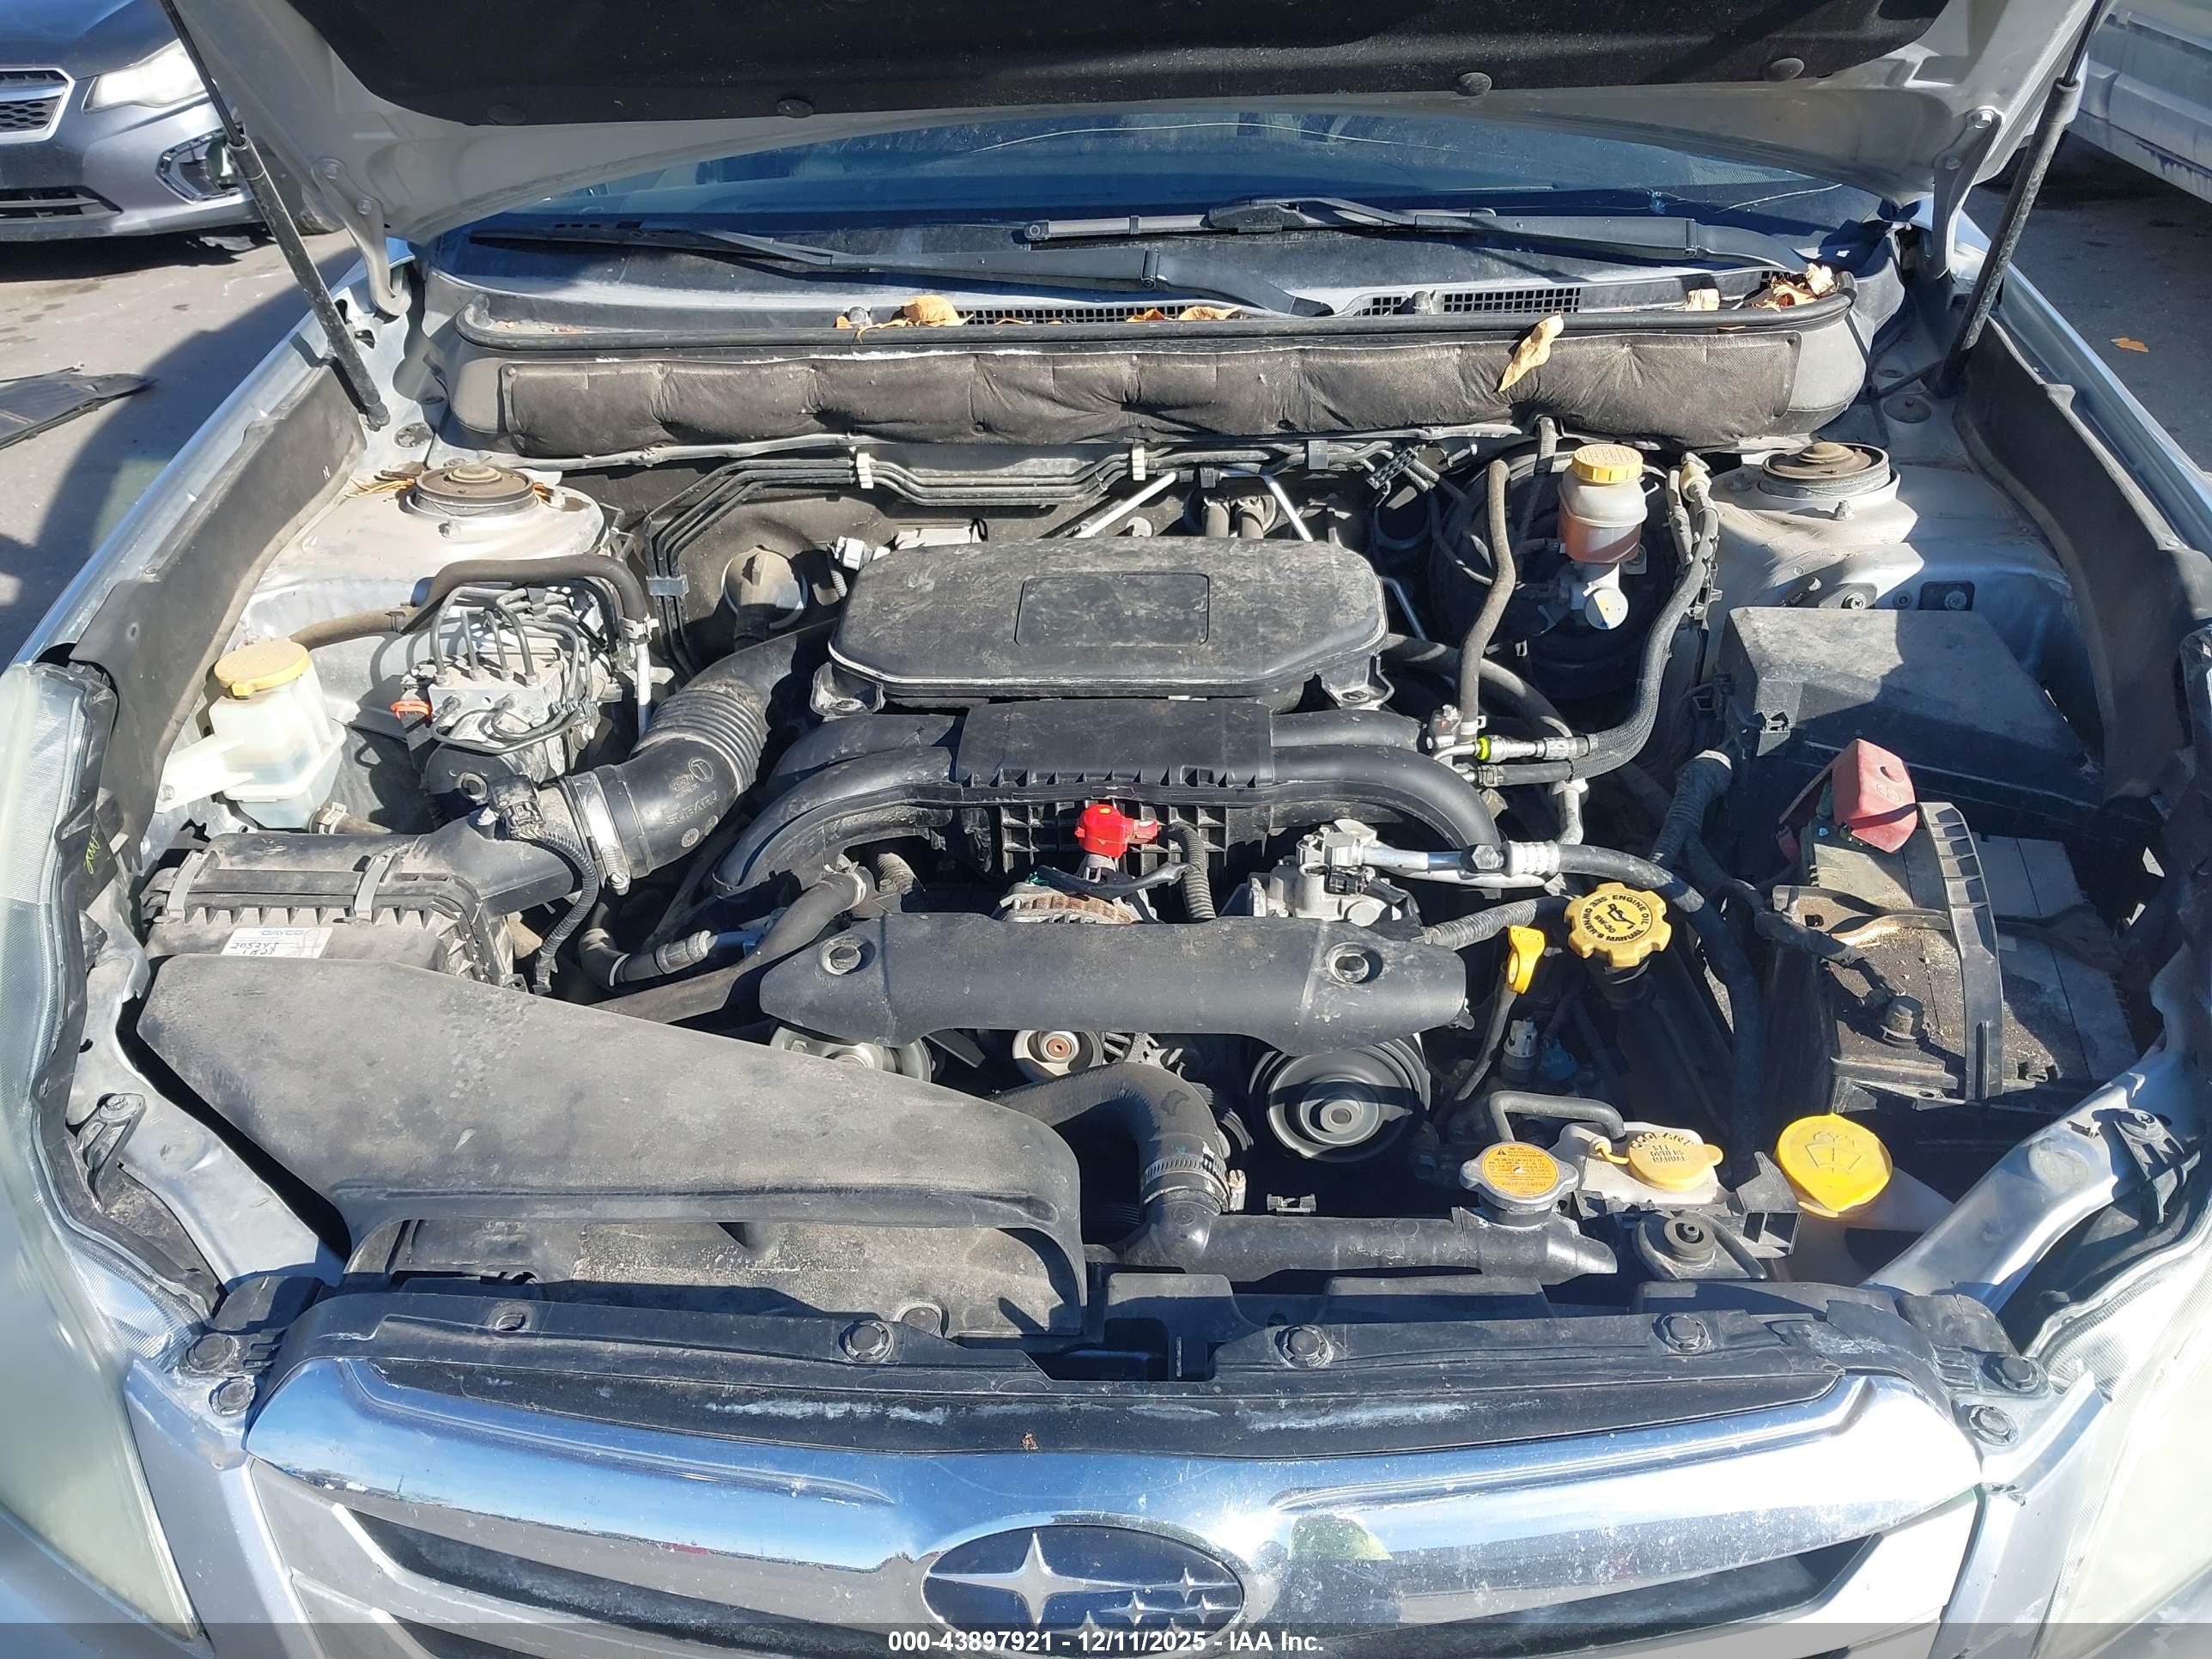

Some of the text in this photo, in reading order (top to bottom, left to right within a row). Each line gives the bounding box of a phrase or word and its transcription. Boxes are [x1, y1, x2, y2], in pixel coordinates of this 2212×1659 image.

[1589, 896, 1608, 908] SEE
[1605, 929, 1644, 942] MANUAL
[1612, 894, 1650, 926] ENGINE OIL
